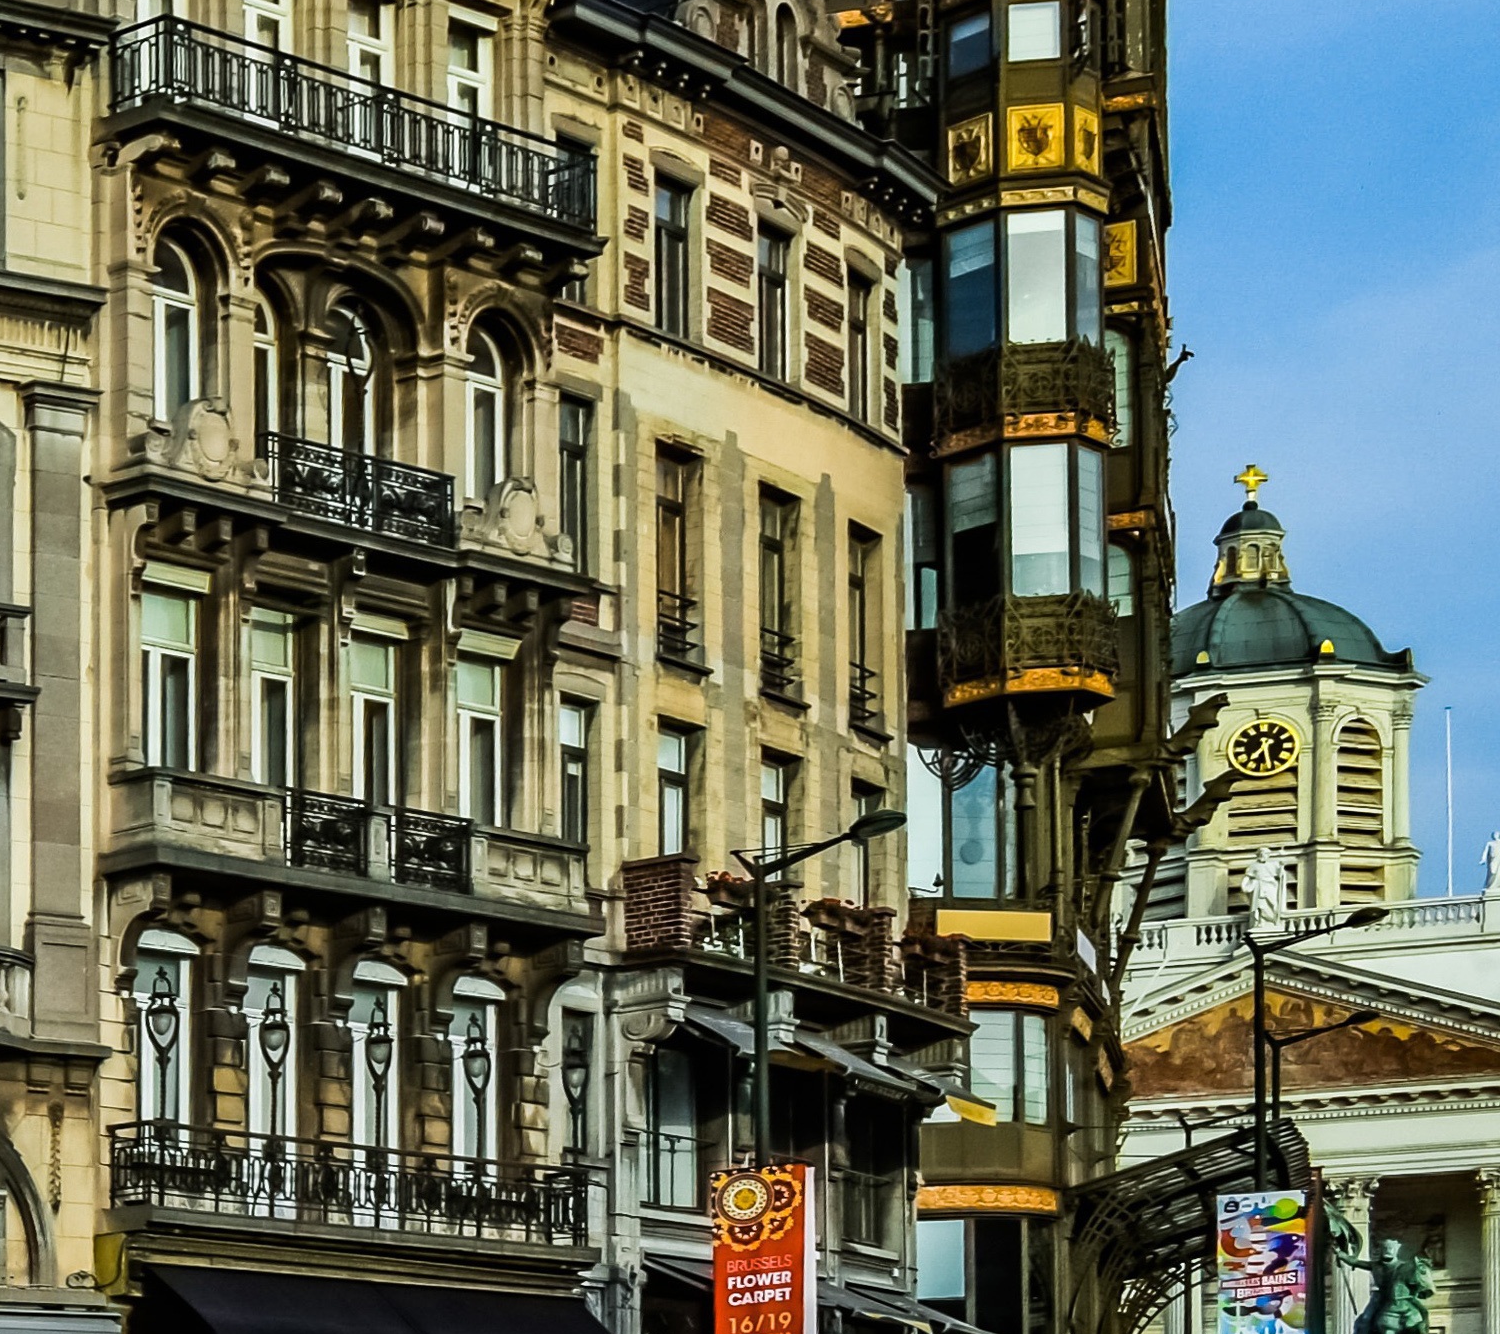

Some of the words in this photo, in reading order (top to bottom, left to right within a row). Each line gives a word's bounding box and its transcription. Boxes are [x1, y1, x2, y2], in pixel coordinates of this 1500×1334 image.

[726, 1254, 793, 1274] BRUSSELS
[727, 1270, 792, 1290] FLOWER
[727, 1287, 793, 1307] CARPET
[728, 1311, 792, 1334] 16/19
